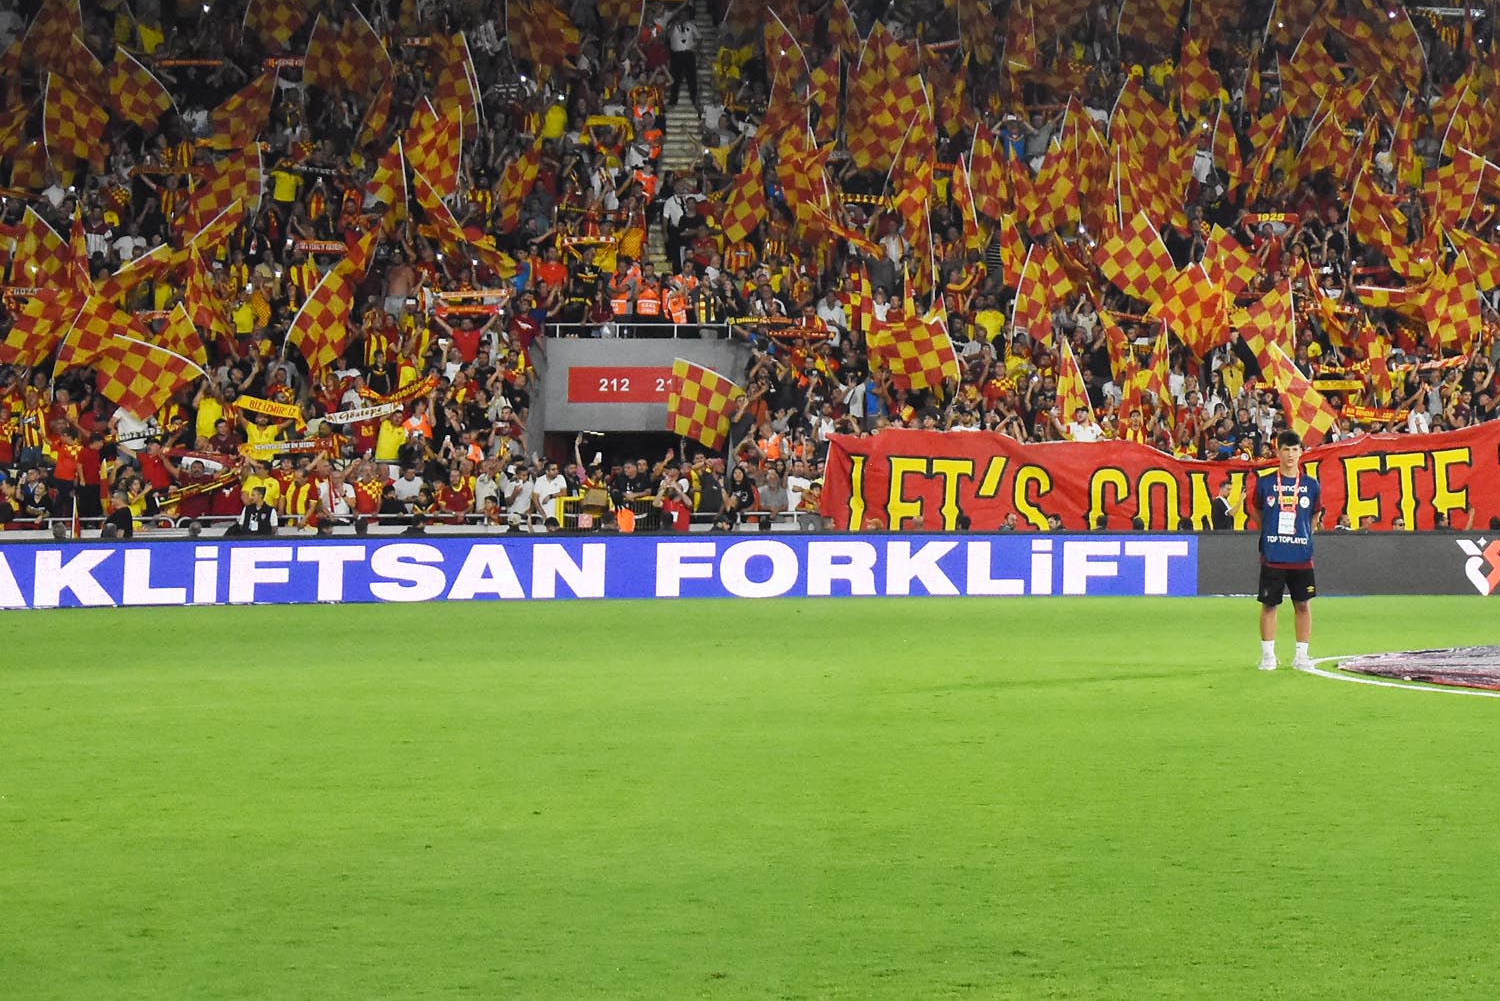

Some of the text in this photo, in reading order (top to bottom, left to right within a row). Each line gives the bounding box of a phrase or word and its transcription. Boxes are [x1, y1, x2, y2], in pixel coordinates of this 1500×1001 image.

[1256, 213, 1286, 222] 1925
[598, 378, 630, 392] 212
[848, 453, 1052, 531] LET'S
[1088, 447, 1471, 531] COMETE
[1267, 535, 1278, 543] TOP
